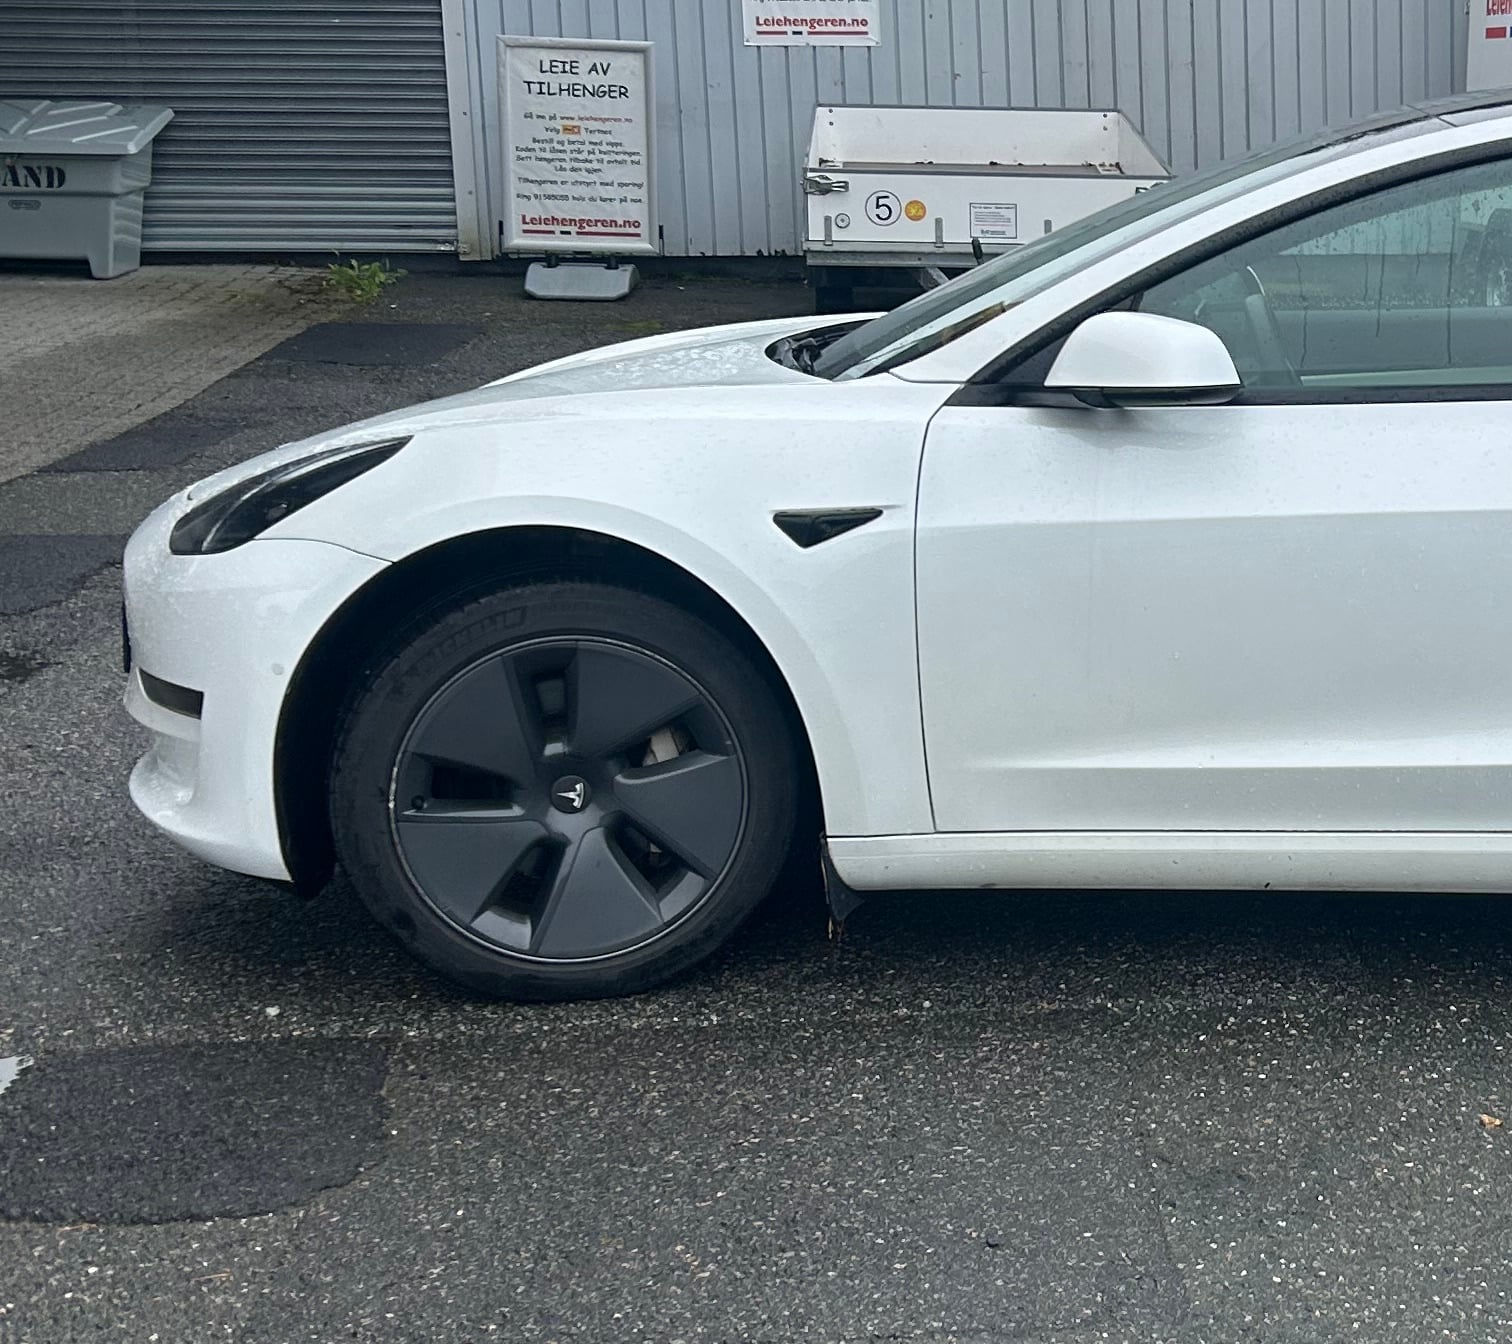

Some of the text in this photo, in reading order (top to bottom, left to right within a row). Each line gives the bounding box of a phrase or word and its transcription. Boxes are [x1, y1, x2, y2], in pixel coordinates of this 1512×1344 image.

[755, 15, 869, 30] Leiehengeren.no
[539, 59, 611, 75] LEIE AV
[523, 80, 630, 99] TILHENGER
[0, 164, 66, 188] AND
[875, 195, 892, 221] 5
[521, 214, 641, 230] Leiehengeren.no
